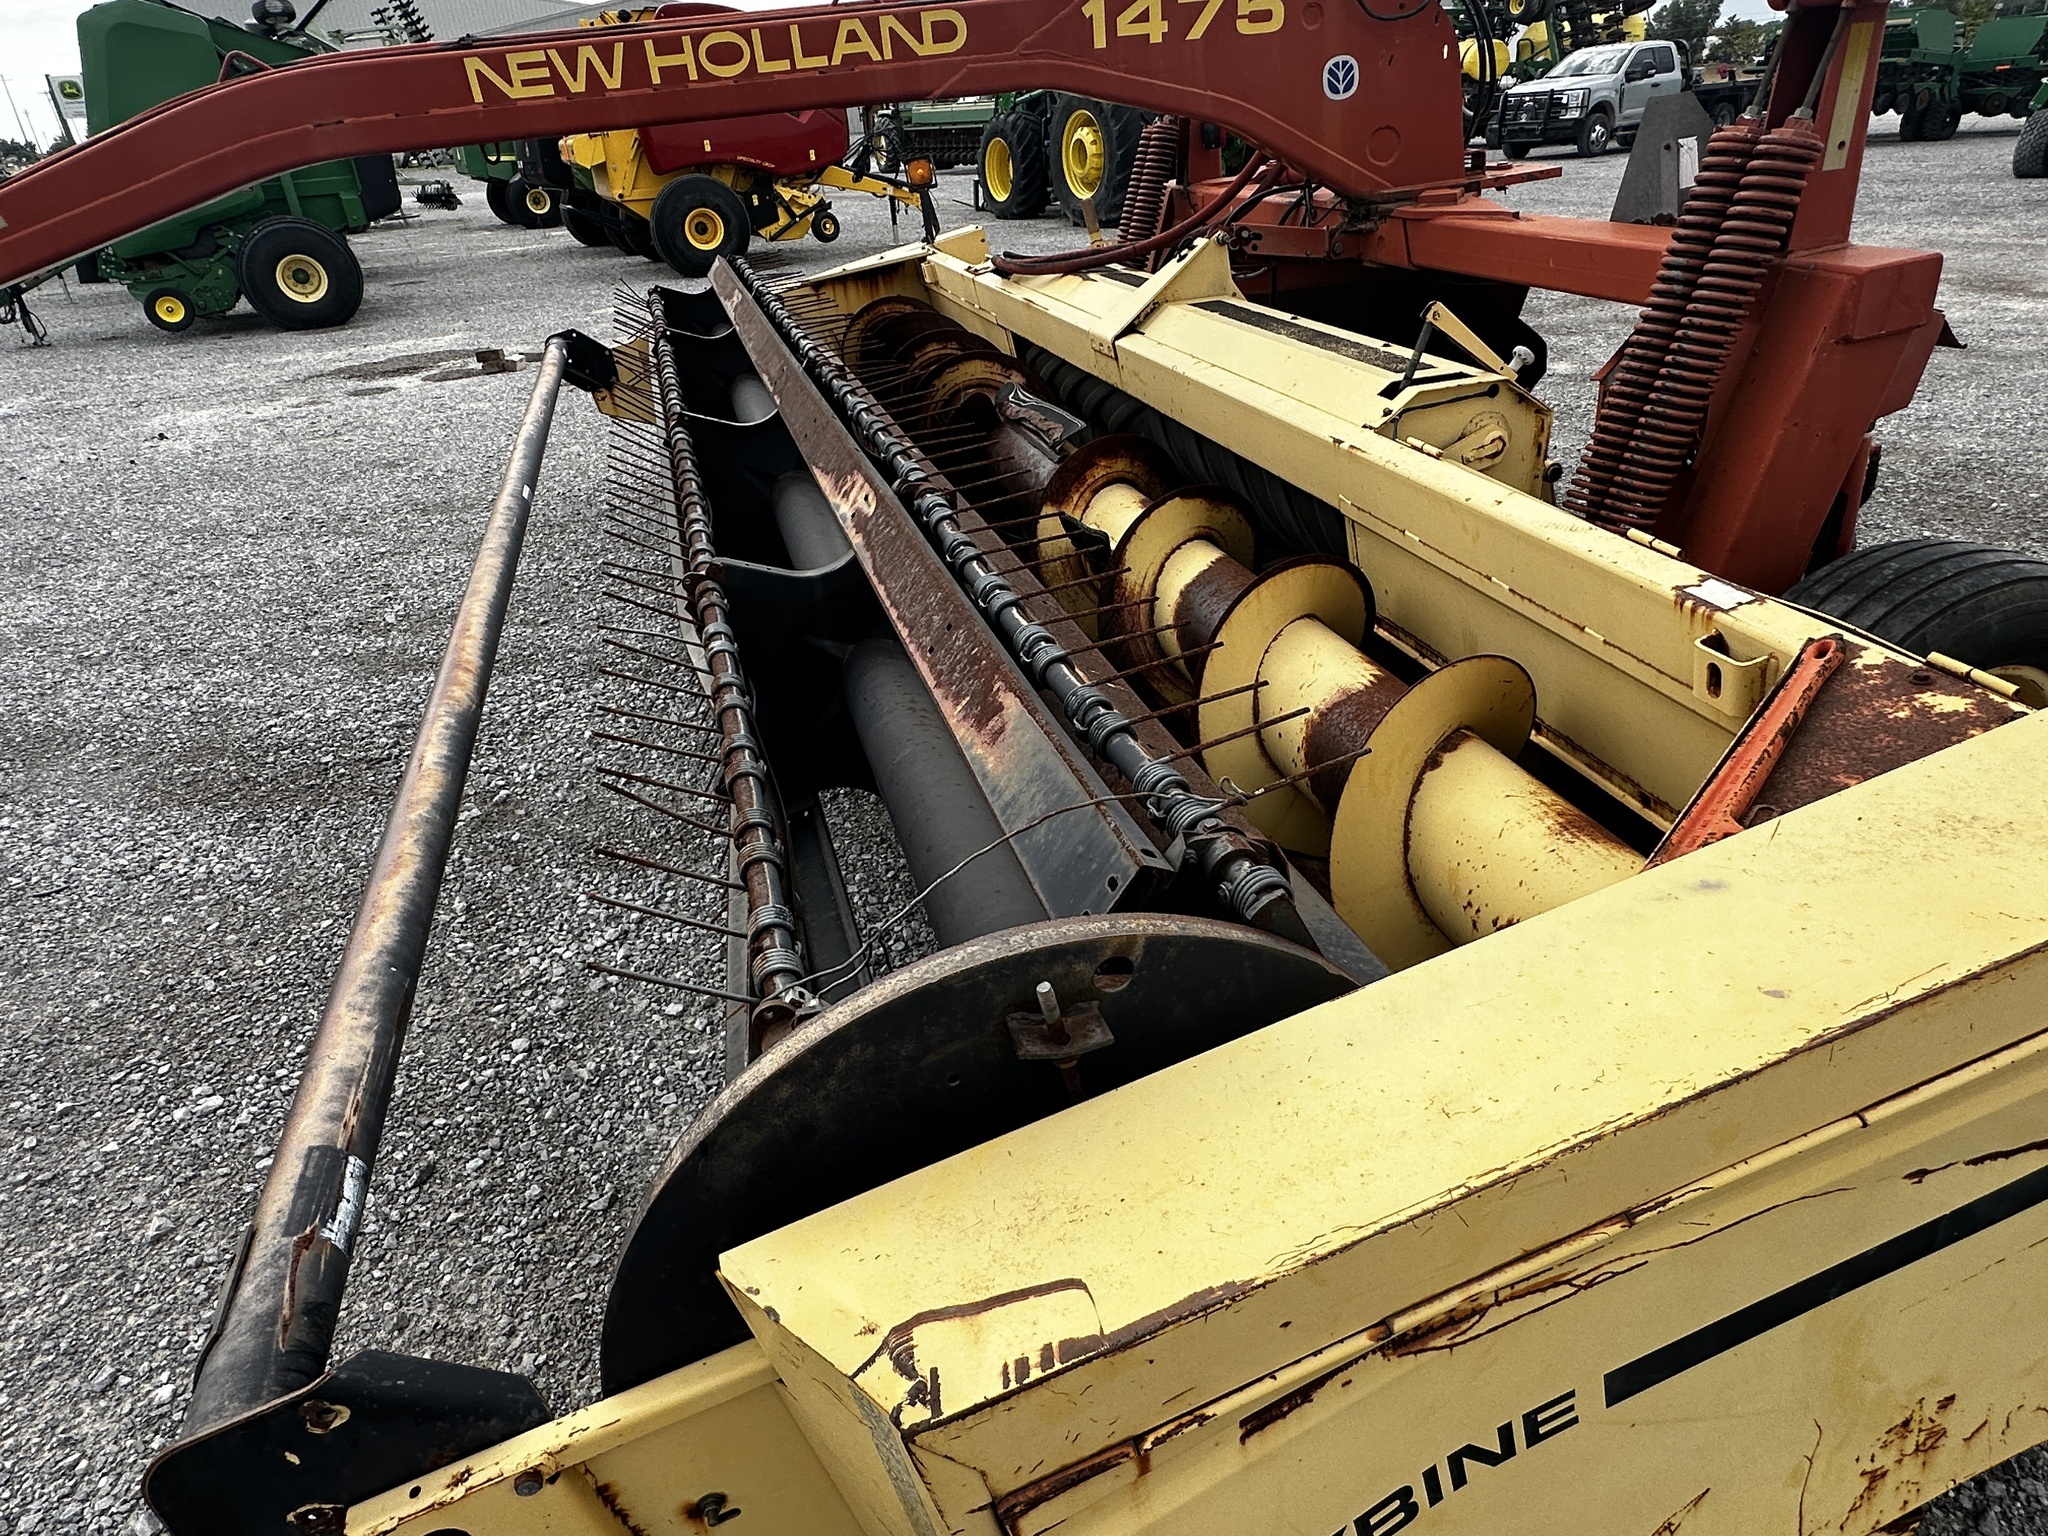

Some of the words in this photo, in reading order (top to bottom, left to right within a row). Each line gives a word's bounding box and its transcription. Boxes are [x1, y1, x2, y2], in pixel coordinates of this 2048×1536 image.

[463, 41, 624, 104] NEW
[644, 9, 968, 85] HOLLAND
[1081, 0, 1285, 49] 1475
[1332, 1388, 1580, 1536] BINE
